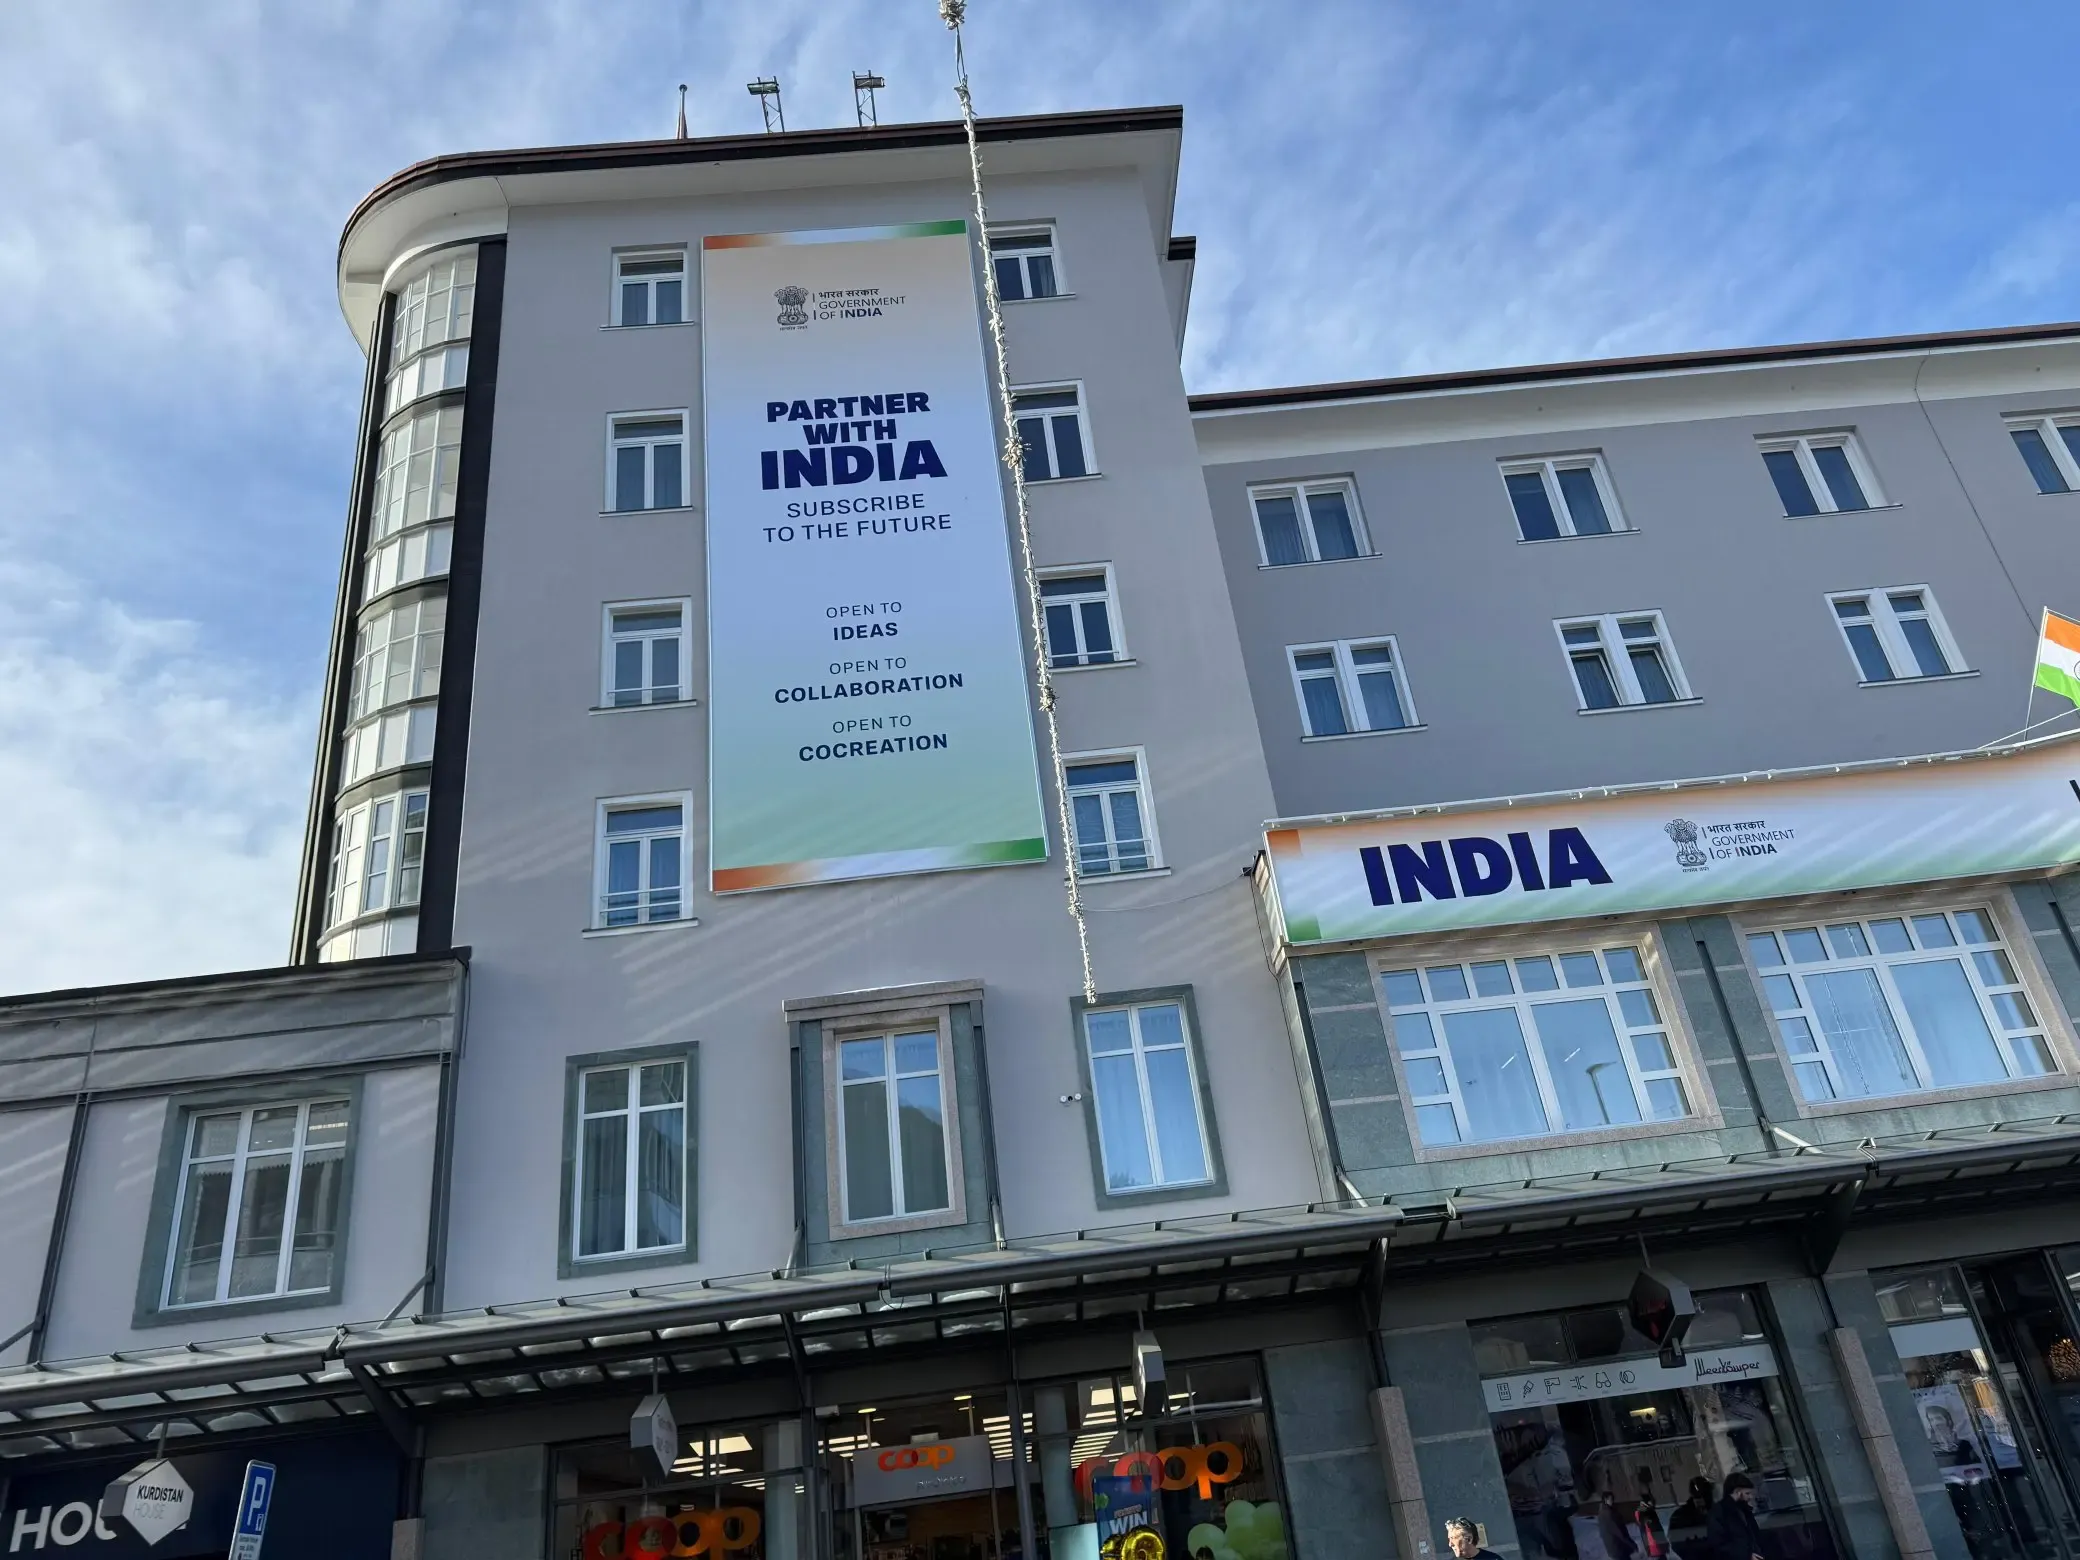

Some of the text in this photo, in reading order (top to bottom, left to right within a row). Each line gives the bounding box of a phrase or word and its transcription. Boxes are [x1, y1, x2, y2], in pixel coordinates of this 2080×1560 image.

[819, 288, 880, 299] भारत सरकार
[819, 296, 906, 309] GOVERNMENT
[819, 307, 883, 320] OF INDIA
[767, 391, 931, 422] PARTNER
[802, 418, 897, 446] WITH
[761, 439, 948, 490] INDIA
[787, 493, 925, 518] SUBSCRIBE
[763, 514, 952, 543] TO THE FUTURE
[826, 601, 902, 619] OPEN TO
[833, 622, 898, 641] IDEAS
[829, 657, 907, 675] OPEN TO
[774, 673, 964, 704] COLLABORATION
[832, 714, 912, 734] OPEN TO
[799, 733, 948, 762] COCREATION
[1707, 820, 1766, 834] भारत सरकार
[1712, 829, 1795, 846] GOVERNMENT
[1716, 843, 1777, 859] OF INDIA
[1359, 826, 1614, 907] INDIA
[878, 1445, 956, 1471] coop
[136, 1485, 185, 1503] KURDISTAN
[247, 1476, 267, 1526] P
[133, 1502, 166, 1520] HOUSE
[1109, 1510, 1148, 1535] WIN
